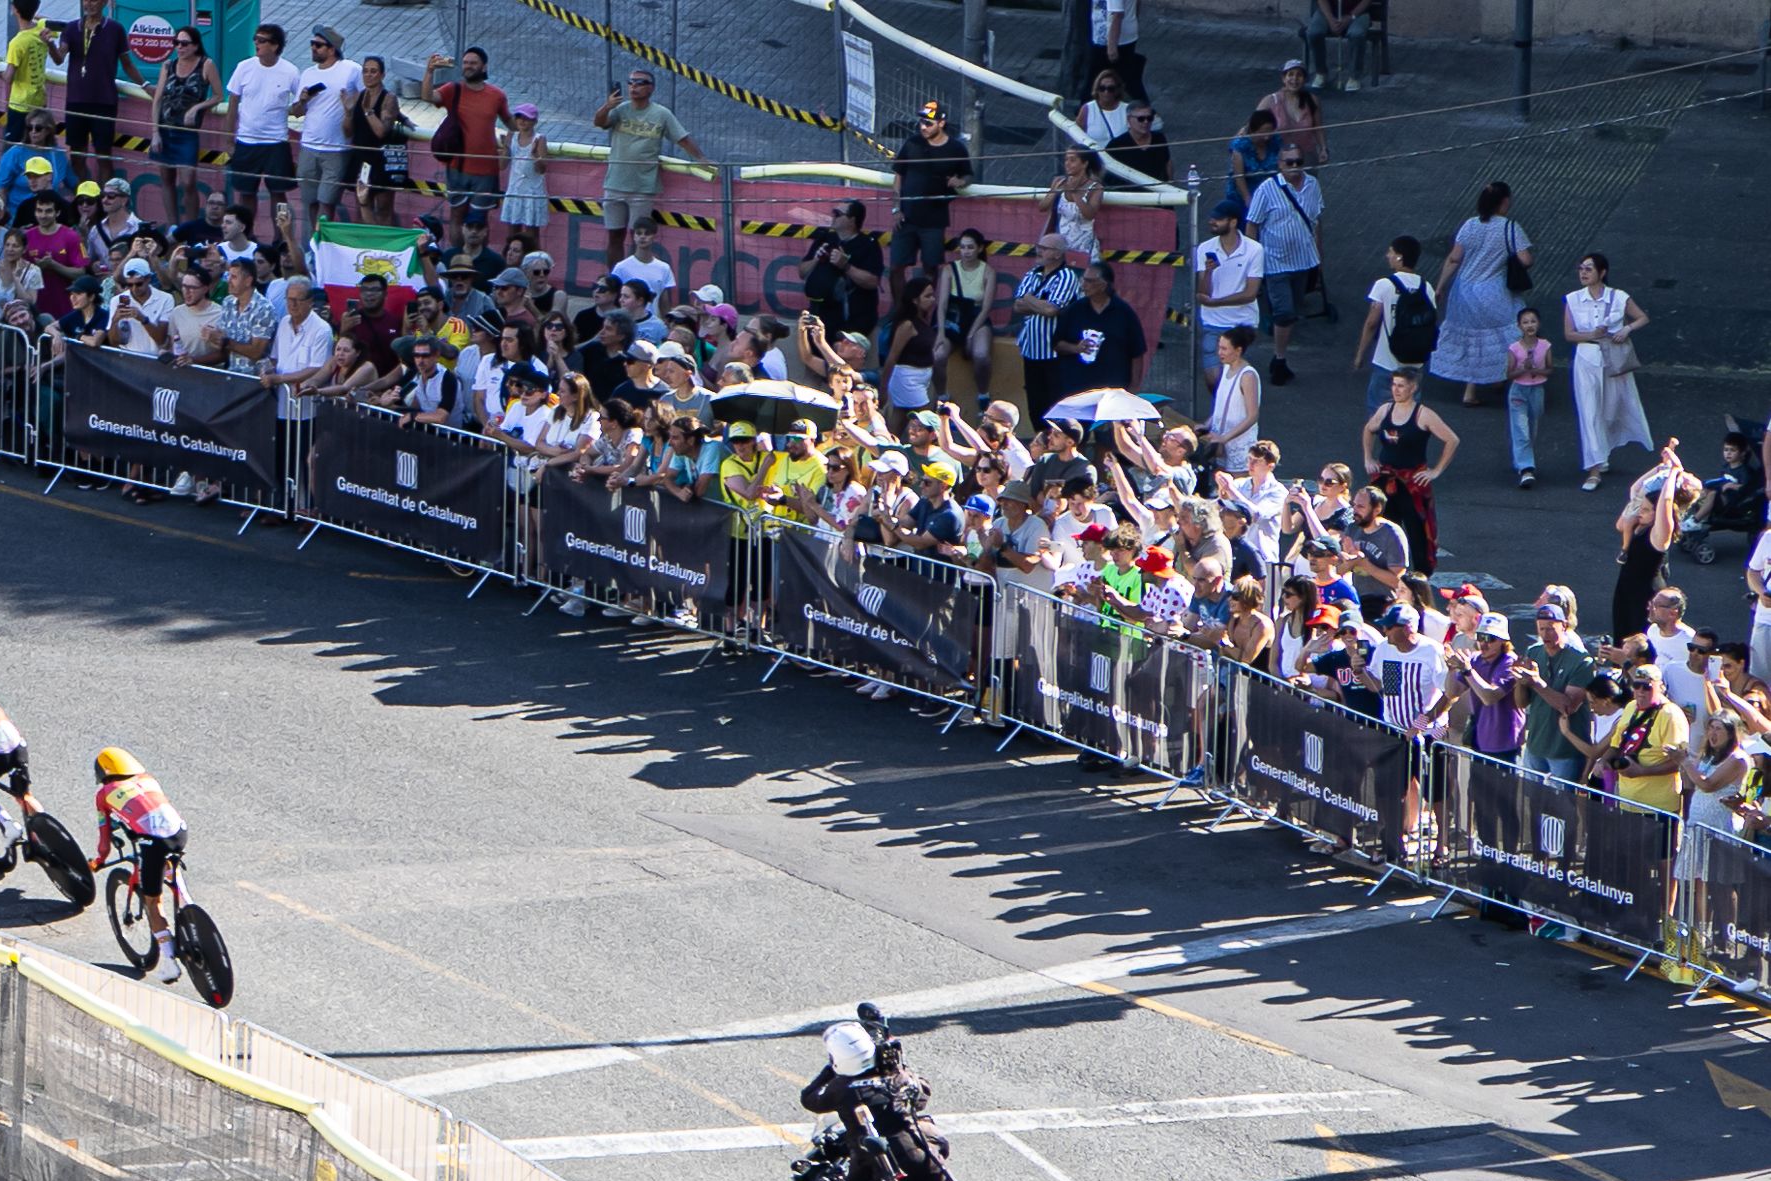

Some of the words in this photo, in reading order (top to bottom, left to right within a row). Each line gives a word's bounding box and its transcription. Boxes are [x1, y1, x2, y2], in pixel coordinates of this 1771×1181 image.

[88, 413, 159, 441] Generalitat
[160, 428, 178, 446] de
[180, 434, 247, 462] Catalunya
[337, 475, 400, 507] Generalitat
[401, 495, 416, 512] de
[418, 499, 477, 530] Catalunya
[565, 531, 629, 564] Generalitat
[630, 549, 647, 567] de
[648, 553, 707, 585] Catalunya
[803, 603, 870, 638] Generalitat
[870, 620, 888, 640] de
[1037, 677, 1095, 712] Generalitat
[1095, 699, 1111, 718] de
[1112, 704, 1168, 738] Catalunya
[1250, 753, 1307, 791] Generalitat
[1307, 779, 1322, 799] de
[1322, 786, 1379, 822] Catalunya
[1472, 839, 1546, 875] Generalitat
[1547, 861, 1564, 881] de
[1566, 868, 1634, 904] Catalunya
